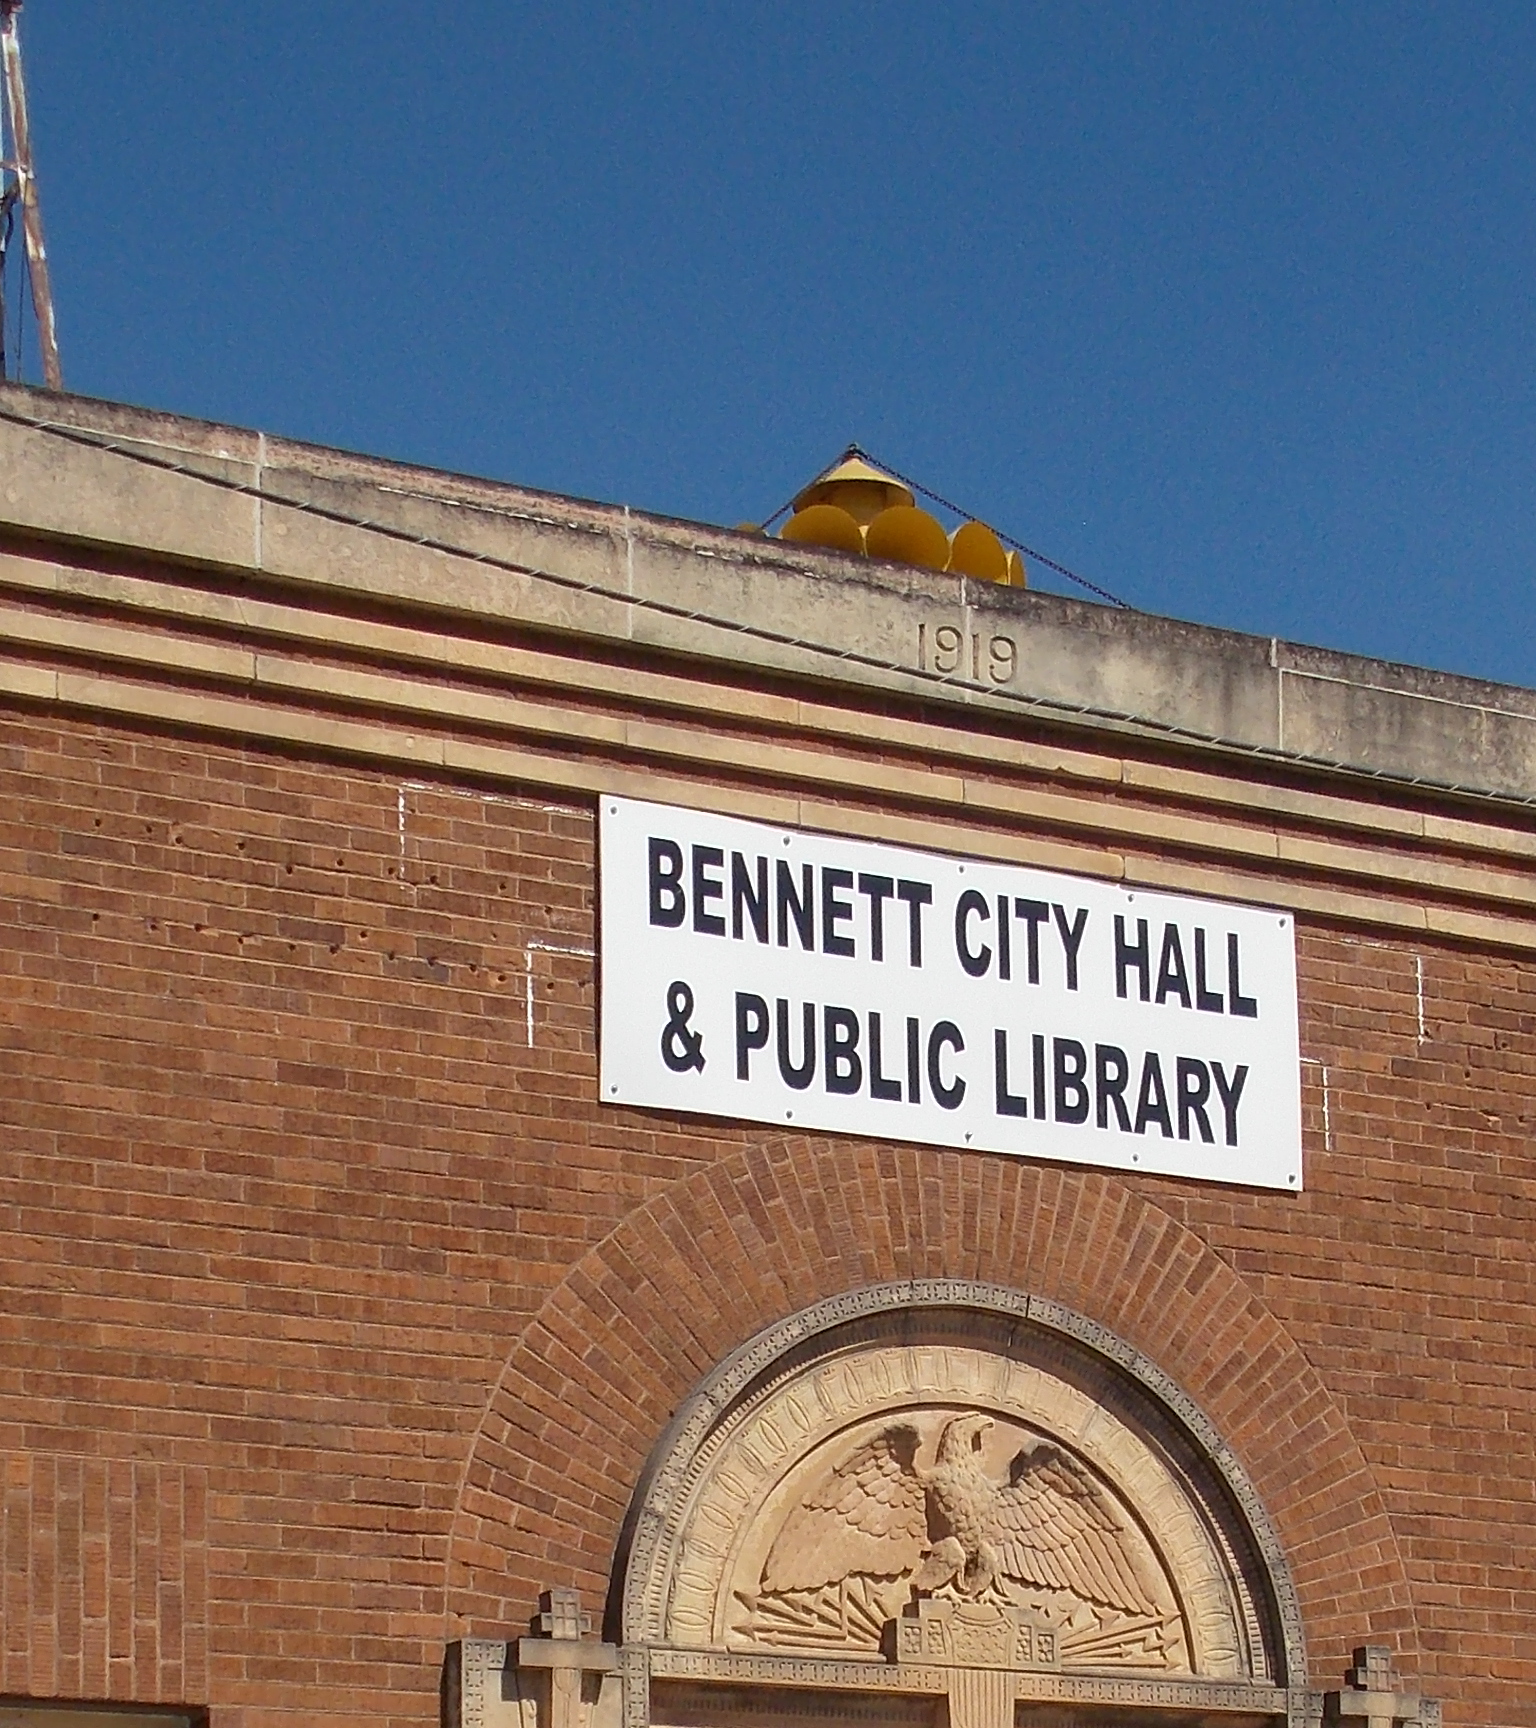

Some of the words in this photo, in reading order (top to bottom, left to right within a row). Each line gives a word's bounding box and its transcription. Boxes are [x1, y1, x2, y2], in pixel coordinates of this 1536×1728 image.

[918, 623, 1018, 684] 1919
[648, 836, 933, 969] BENNETT
[955, 889, 1089, 991] CITY
[1114, 914, 1258, 1019] HALL
[661, 980, 705, 1076] &
[735, 990, 966, 1111] PUBLIC
[994, 1029, 1250, 1147] LIBRARY
